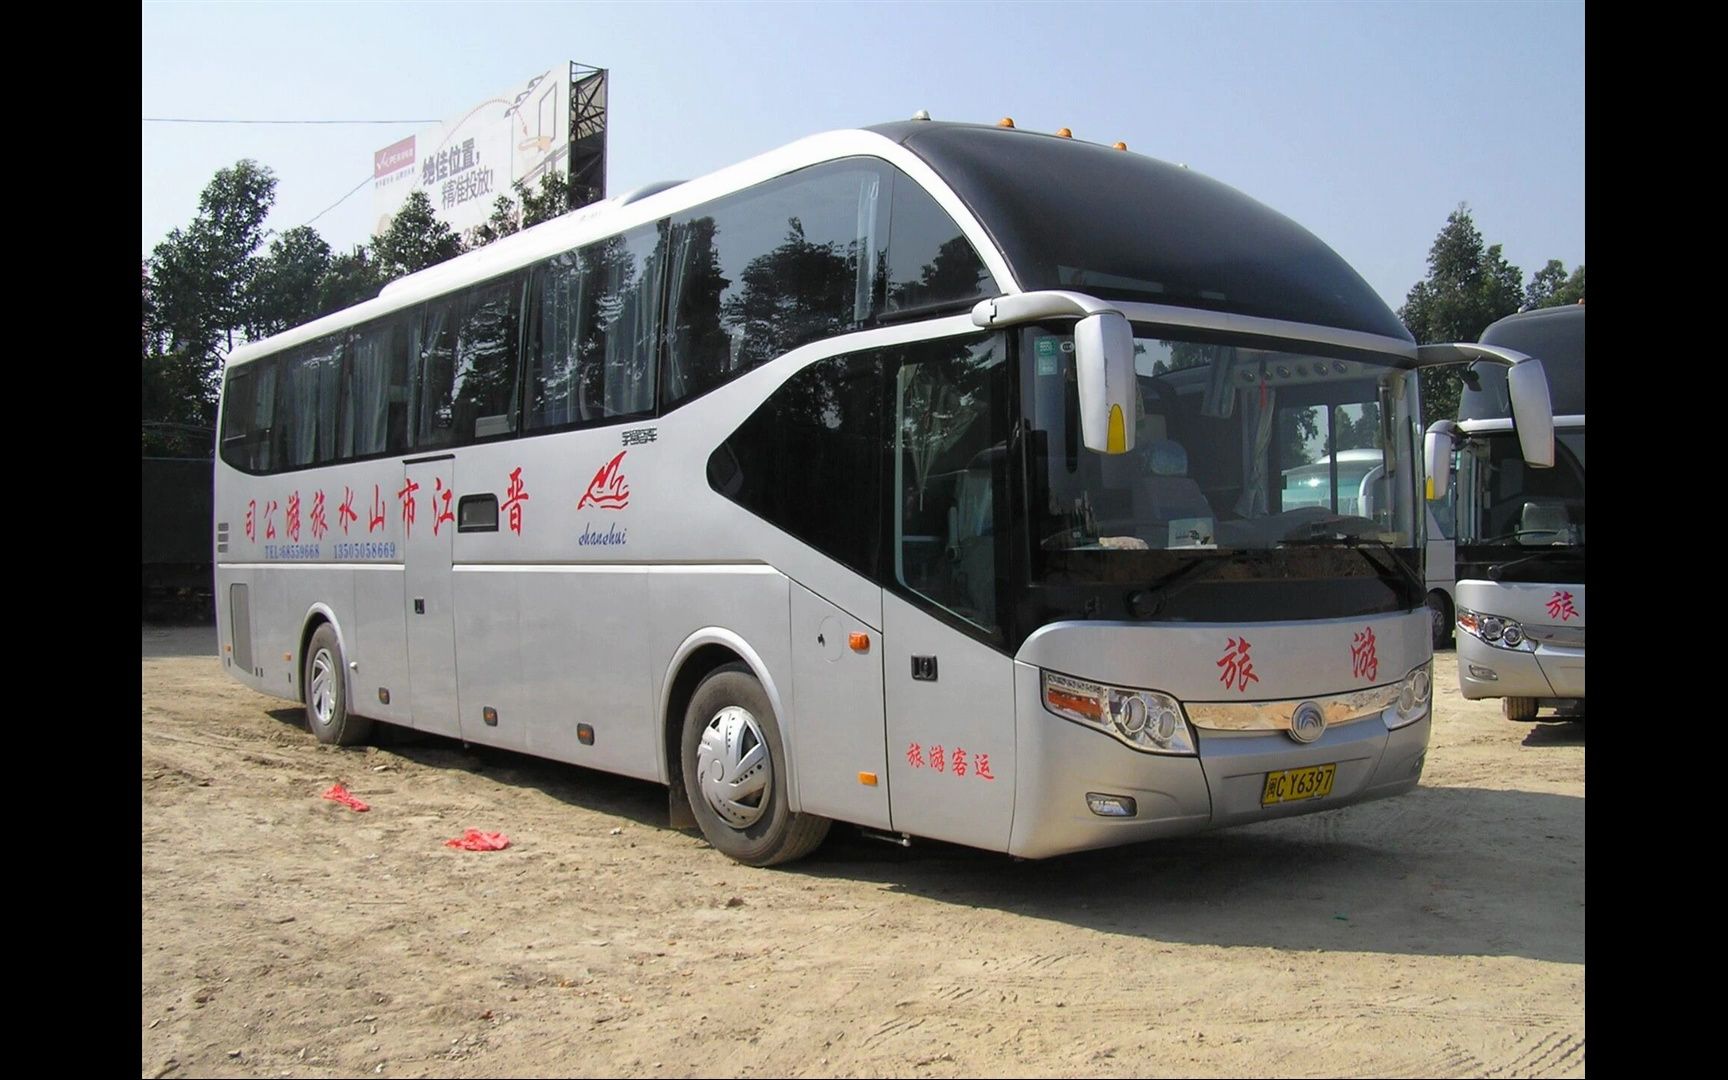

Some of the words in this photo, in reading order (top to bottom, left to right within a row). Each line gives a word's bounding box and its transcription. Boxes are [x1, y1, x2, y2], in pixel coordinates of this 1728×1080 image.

[334, 542, 396, 559] 13505058669
[1545, 591, 1579, 621] 旅
[906, 743, 994, 780] 旅游客运
